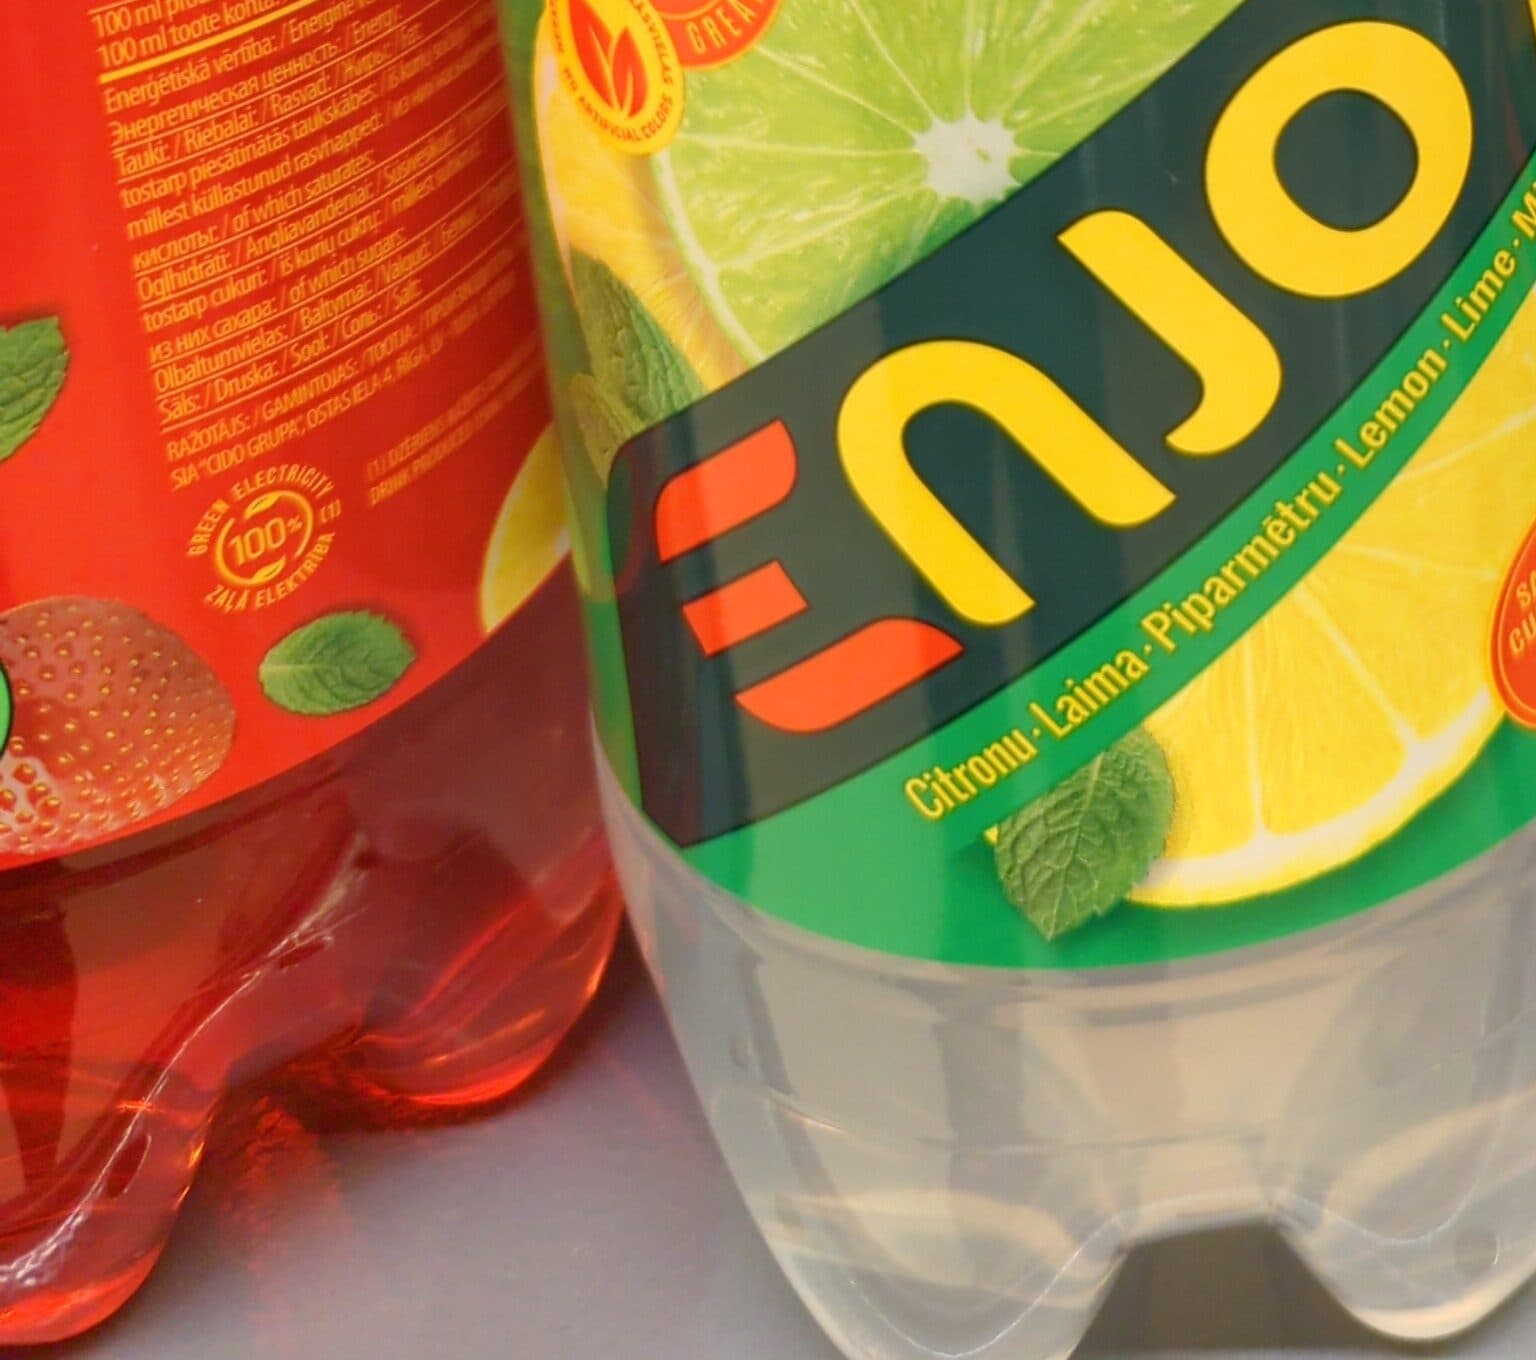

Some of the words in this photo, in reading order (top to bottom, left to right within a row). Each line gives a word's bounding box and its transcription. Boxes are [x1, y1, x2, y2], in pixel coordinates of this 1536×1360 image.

[90, 5, 132, 38] 100
[96, 36, 138, 68] 100
[139, 24, 168, 56] ml
[168, 10, 221, 47] toote
[118, 169, 189, 210] tostarp
[126, 200, 193, 241] millest
[191, 154, 293, 217] küllastunud
[142, 293, 209, 334] tostarp
[149, 340, 173, 365] из
[174, 323, 212, 351] них
[168, 462, 201, 493] SIA
[306, 390, 351, 429] OSTAS
[186, 497, 230, 558] GREEN
[230, 463, 336, 500] ELECTRICITY
[902, 726, 1038, 823] Citronu
[1030, 645, 1151, 740] Laima
[1142, 463, 1345, 659] Piparmētru
[1335, 345, 1448, 470] Lemon
[1440, 248, 1519, 342] Lime
[228, 515, 303, 567] 100%
